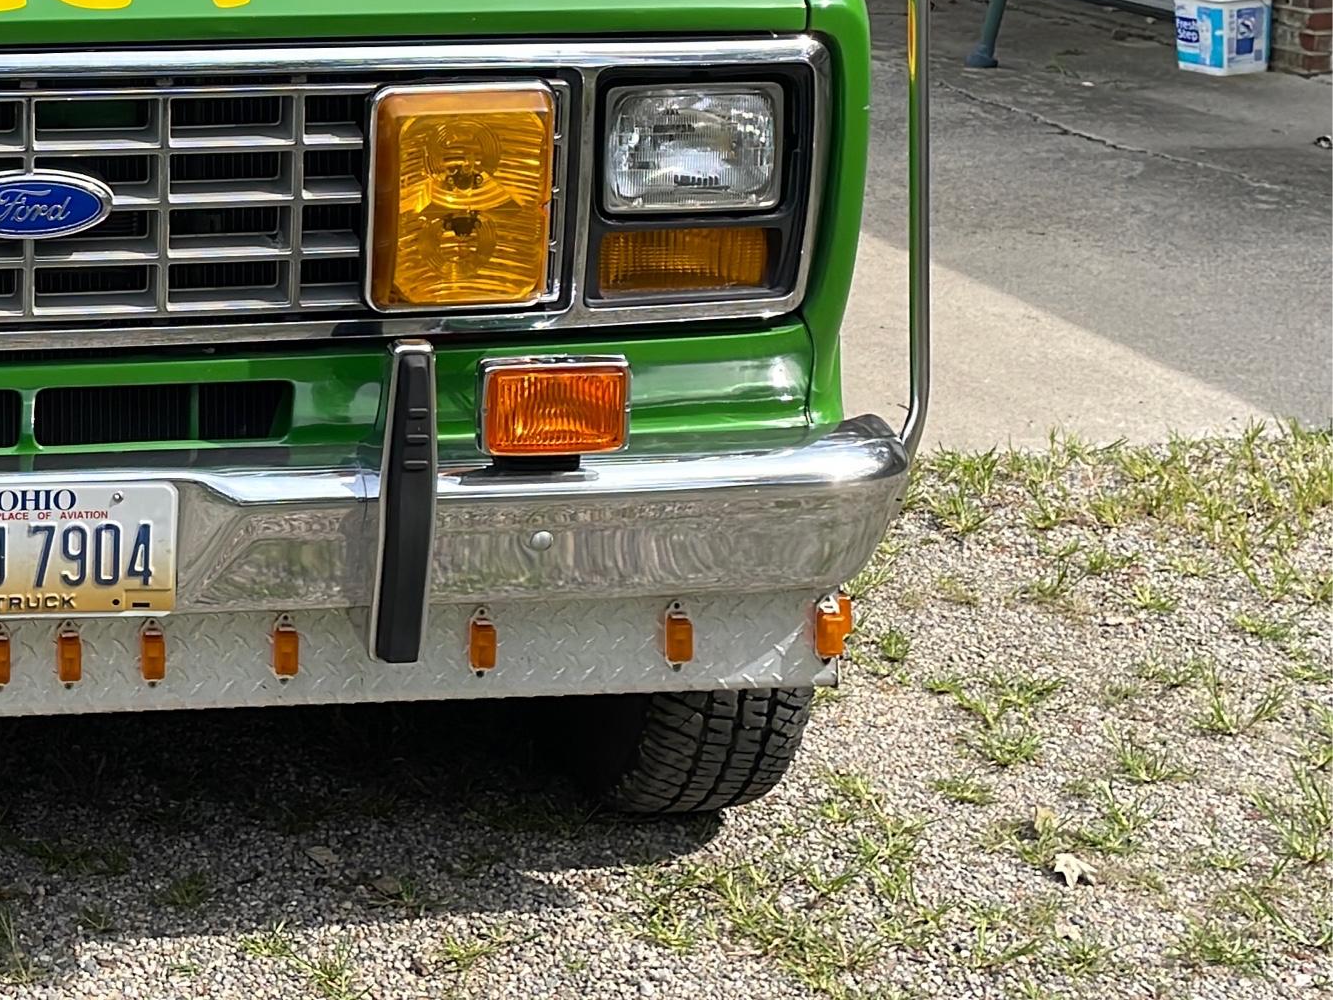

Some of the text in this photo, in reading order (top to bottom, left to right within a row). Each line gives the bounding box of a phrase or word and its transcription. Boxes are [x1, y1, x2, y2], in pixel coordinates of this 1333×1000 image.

[1177, 28, 1199, 42] Step
[37, 511, 52, 520] OF
[59, 510, 109, 520] AVIATION
[27, 519, 154, 589] 7904
